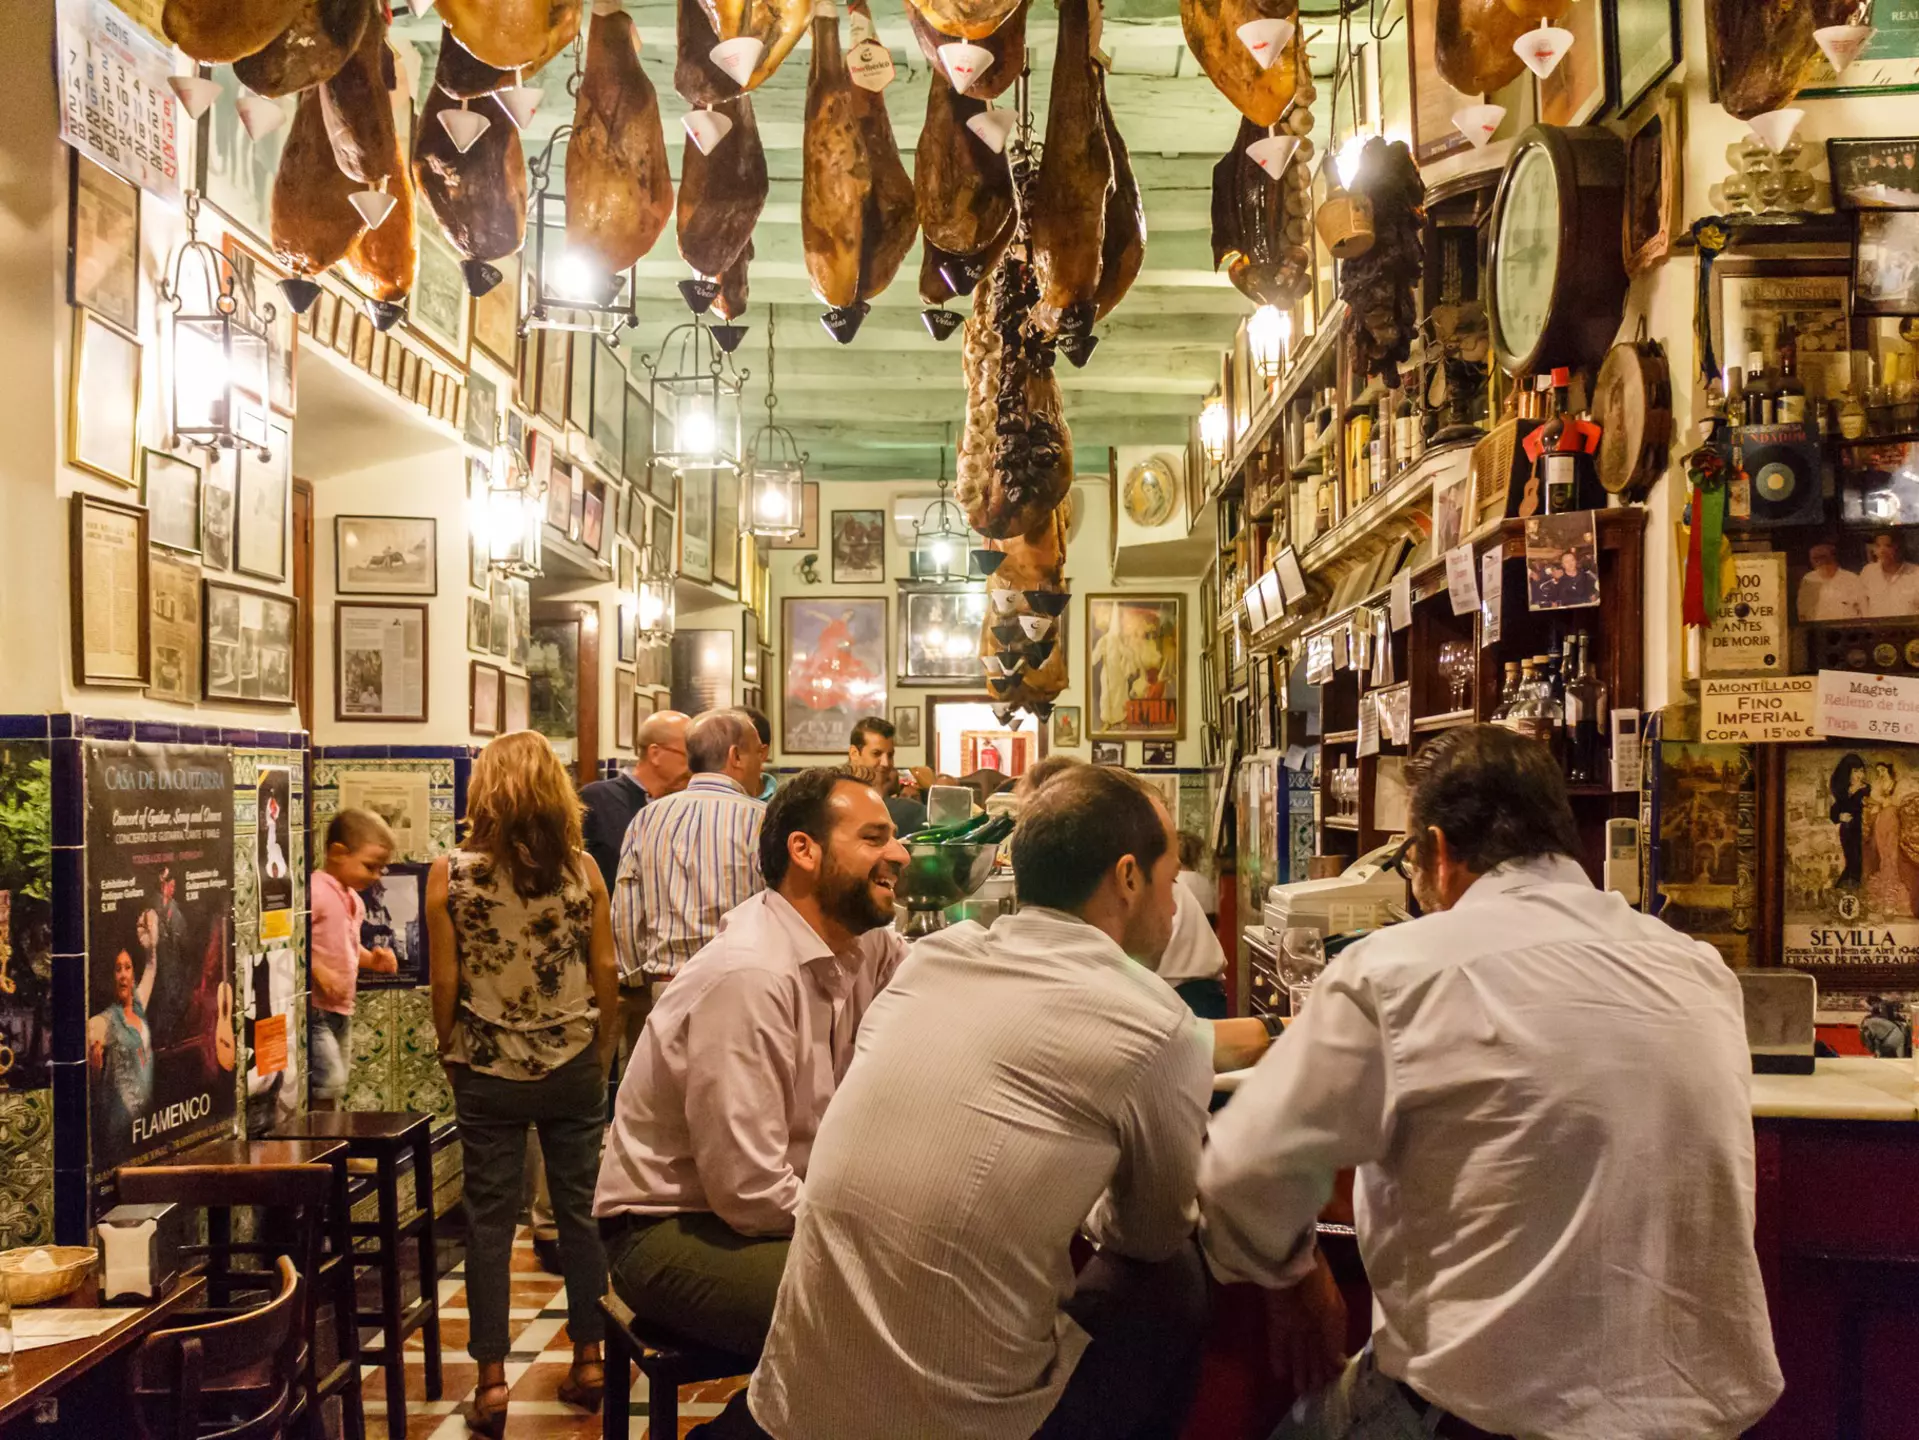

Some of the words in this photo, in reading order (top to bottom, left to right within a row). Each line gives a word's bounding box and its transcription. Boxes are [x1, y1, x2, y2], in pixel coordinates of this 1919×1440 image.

[105, 16, 129, 45] 2015
[69, 50, 77, 65] 7
[102, 75, 111, 93] 9
[116, 84, 129, 107] 10
[133, 98, 144, 117] 11
[147, 107, 159, 129] 12
[101, 53, 110, 71] 2
[117, 65, 126, 83] 3
[133, 79, 141, 95] 4
[148, 89, 156, 106] 5
[163, 100, 172, 116] 6
[68, 70, 81, 94] 14
[85, 83, 98, 105] 15
[101, 96, 115, 117] 16
[118, 106, 129, 126] 17
[133, 118, 146, 139] 18
[149, 131, 161, 151] 19
[69, 95, 84, 118] 21
[85, 106, 101, 129] 22
[102, 118, 118, 140] 23
[118, 129, 133, 151] 24
[70, 117, 87, 141] 28
[104, 139, 120, 163] 30
[1749, 606, 1774, 616] VER
[1722, 621, 1762, 632] ANTES
[1713, 637, 1729, 647] DE
[1731, 635, 1771, 647] MORIR
[1706, 680, 1813, 693] AMONTILLADO
[1849, 682, 1899, 697] Magret
[1738, 696, 1783, 709] FINO
[1823, 694, 1874, 708] Relleno
[1877, 698, 1894, 710] de
[1717, 711, 1805, 725] IMPERIAL
[1825, 716, 1859, 731] Tapa
[1869, 719, 1900, 735] 3,75
[1706, 729, 1749, 740] COPA
[1805, 725, 1815, 737] €
[104, 766, 136, 790] CASA
[139, 770, 155, 790] DE
[158, 769, 172, 790] LA
[173, 768, 225, 790] GUITARRA
[112, 810, 139, 827] Concert
[1810, 929, 1896, 946] SEVILLA
[1875, 946, 1895, 955] Abril
[1786, 955, 1831, 965] FIESTAS
[1835, 955, 1919, 965] PRIMAVERALES
[132, 1093, 211, 1144] FLAMENCO
